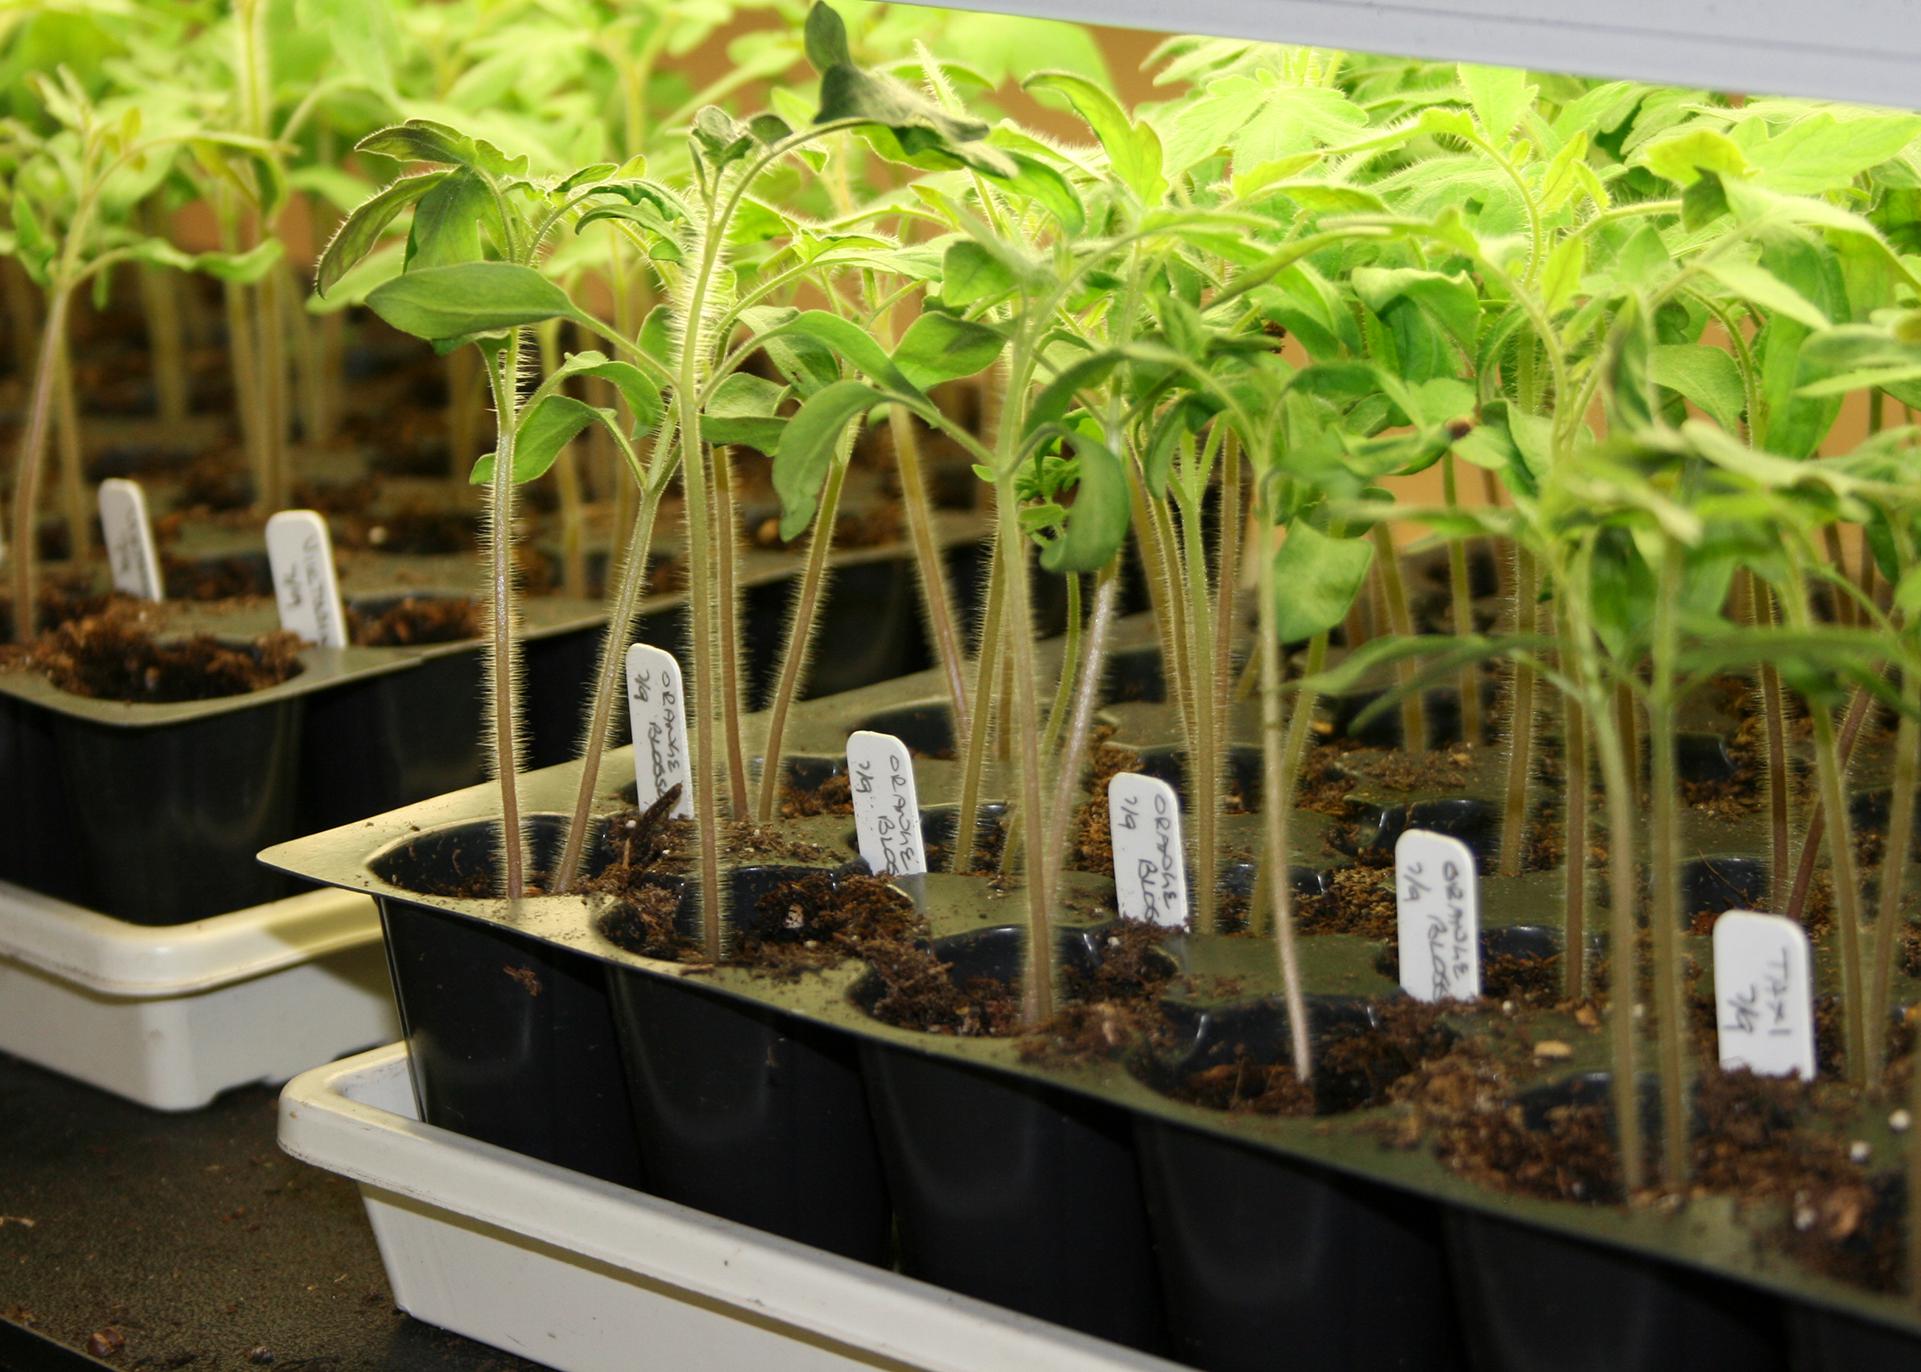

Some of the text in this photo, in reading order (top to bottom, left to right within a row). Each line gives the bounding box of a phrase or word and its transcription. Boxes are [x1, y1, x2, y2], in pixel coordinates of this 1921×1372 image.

[661, 671, 681, 773] ORANGE
[856, 760, 874, 793] 7/9
[889, 754, 915, 871] ORANGE
[1118, 796, 1140, 830] 7/9
[1154, 793, 1178, 910] ORANGE
[1442, 861, 1469, 981] ORANGE
